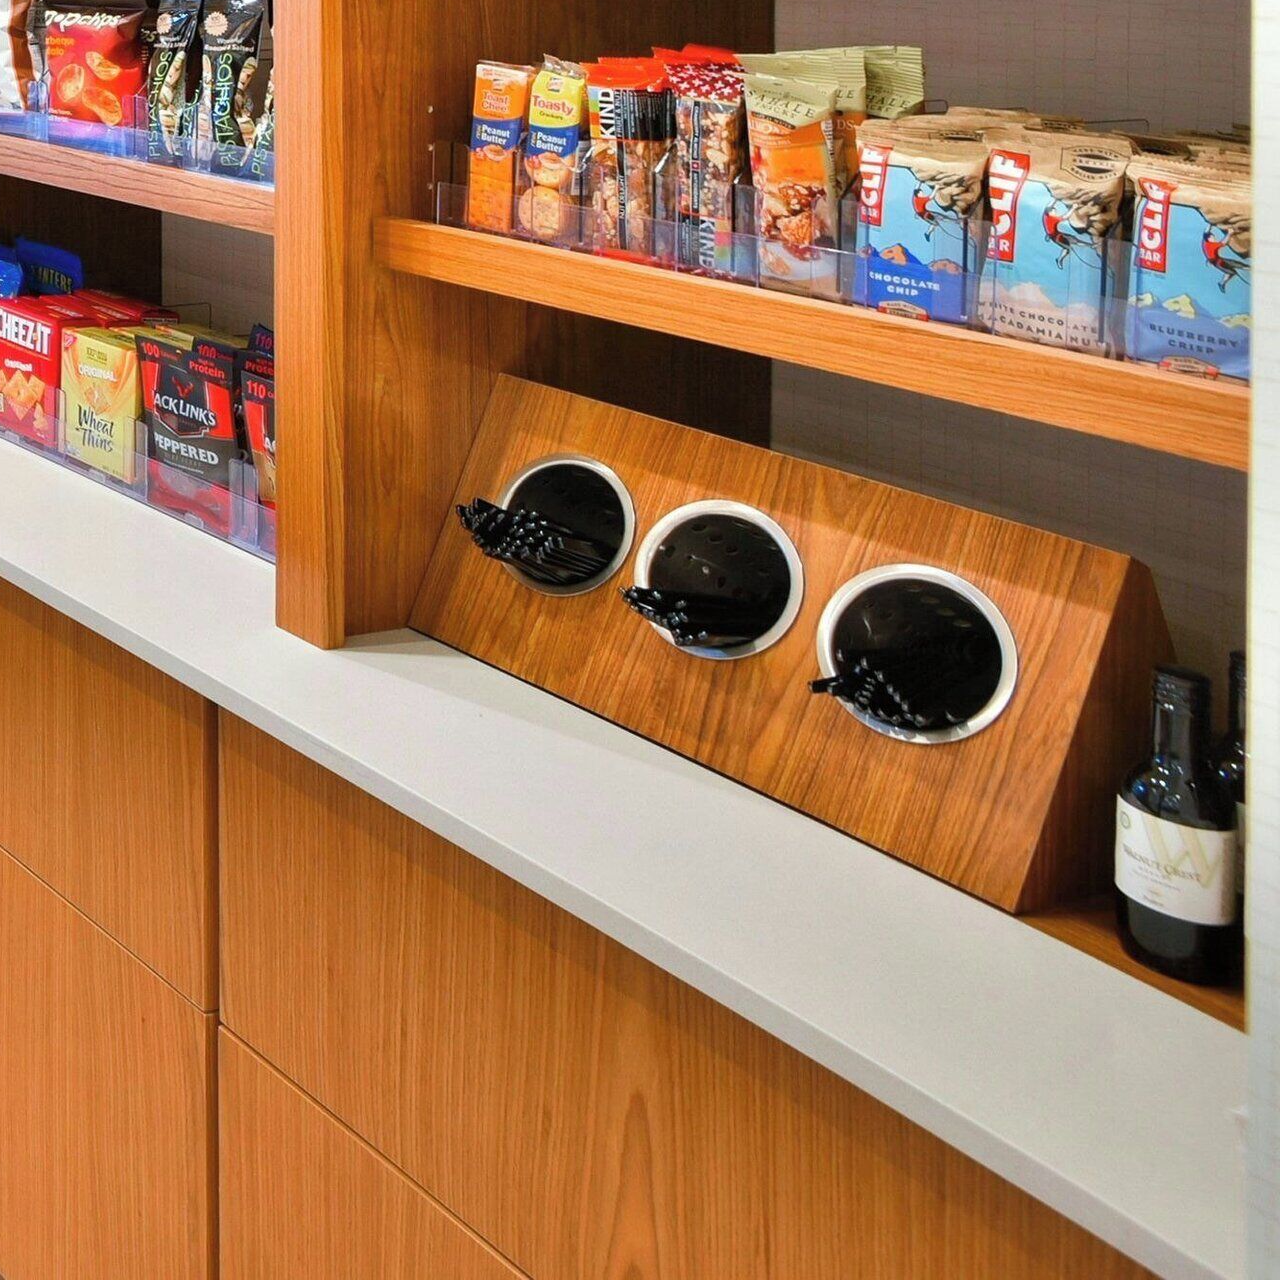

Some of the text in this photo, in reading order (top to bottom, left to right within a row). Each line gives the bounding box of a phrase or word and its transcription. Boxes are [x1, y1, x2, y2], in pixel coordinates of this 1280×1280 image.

[149, 51, 173, 157] PISTACHIOS
[213, 52, 240, 166] PISTACHIOS
[483, 90, 509, 105] Toast
[532, 94, 574, 116] Toasty
[748, 89, 817, 119] SAHALE
[598, 89, 615, 138] KIND
[481, 132, 507, 145] Butter
[483, 124, 510, 139] Peanut
[537, 131, 567, 146] Peanut
[536, 140, 563, 153] Butter
[859, 147, 885, 207] CLIF
[989, 154, 1026, 236] CLIF
[1141, 180, 1169, 250] CLIF
[699, 219, 716, 269] KIND
[1139, 248, 1161, 264] BAR
[869, 271, 941, 292] CHOCOLATE
[886, 285, 919, 297] CHIP
[978, 313, 1062, 341] MACADAMIA
[1020, 310, 1100, 335] CHOCOLATE
[1148, 322, 1239, 348] BLUEBERRY
[141, 341, 160, 359] 100
[1168, 339, 1216, 355] CRISP
[188, 361, 225, 380] Protein
[246, 379, 266, 399] 110
[76, 403, 115, 439] Wheat
[80, 427, 114, 453] Thins
[154, 431, 219, 466] PEPPERED
